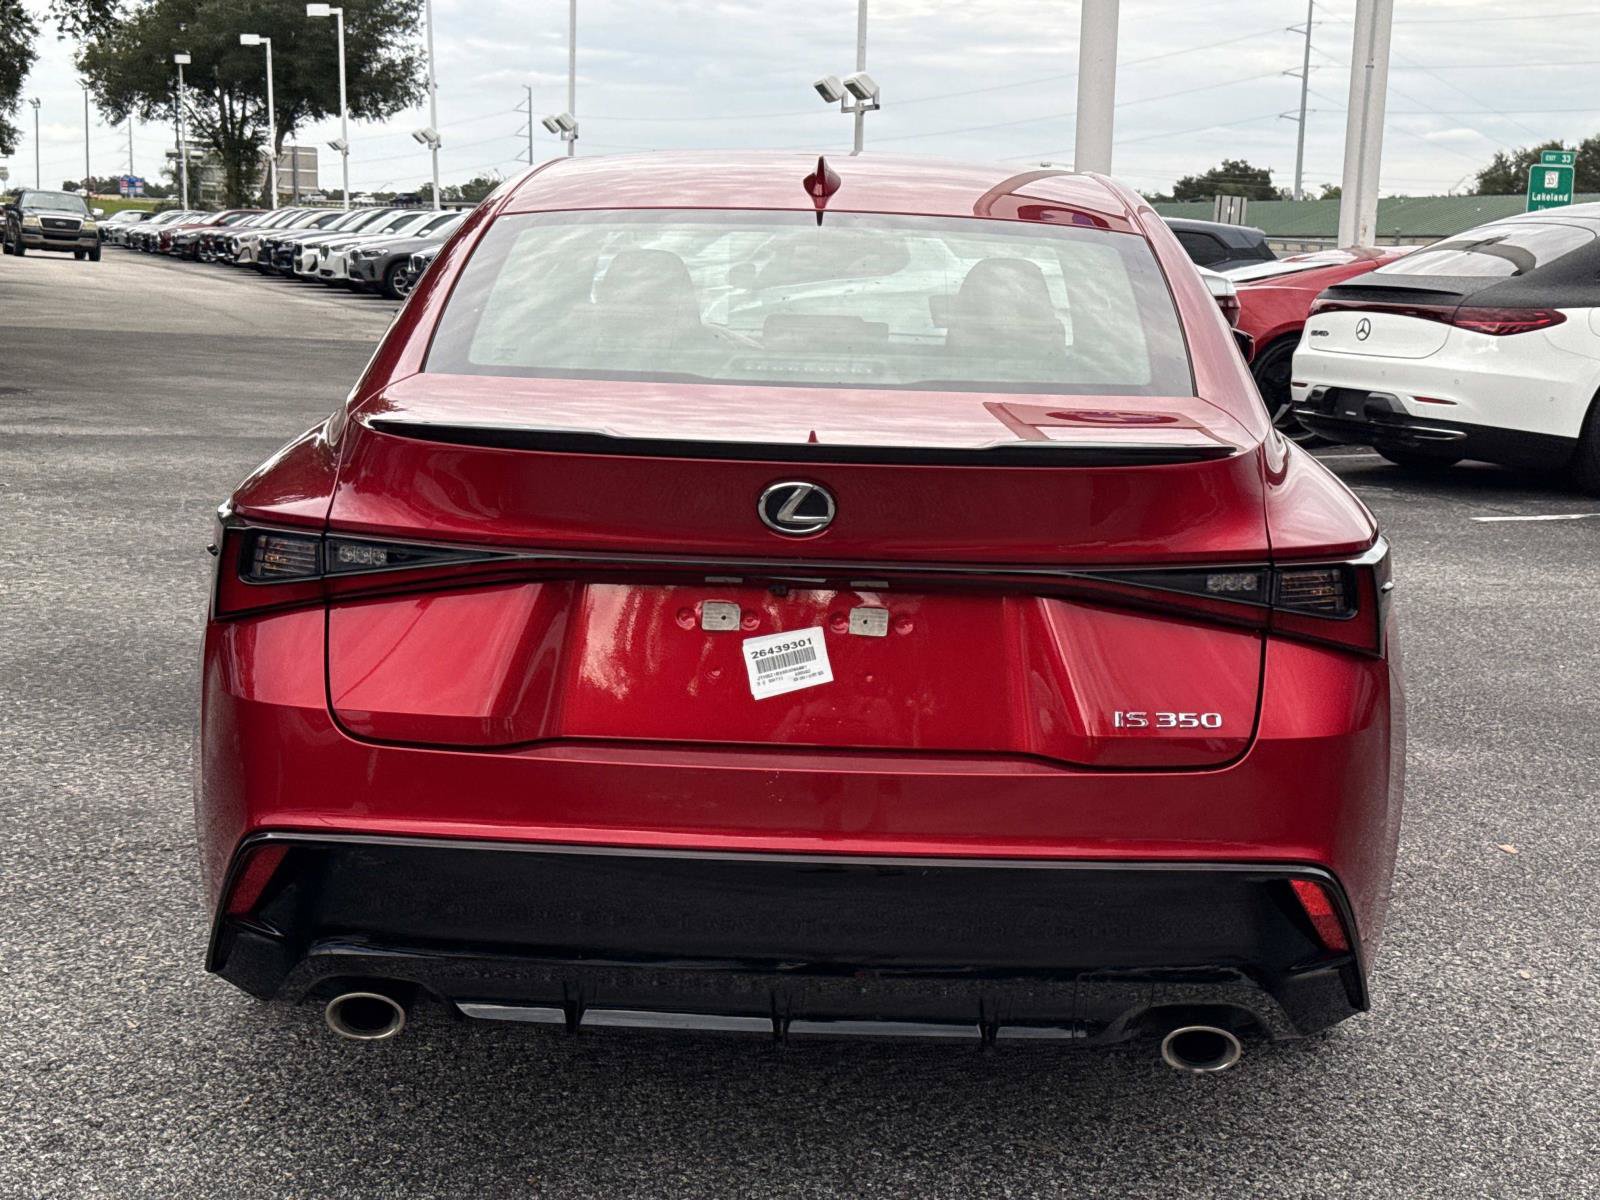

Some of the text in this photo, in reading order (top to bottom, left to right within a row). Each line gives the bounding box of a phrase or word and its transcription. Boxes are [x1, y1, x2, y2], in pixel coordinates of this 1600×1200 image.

[1561, 154, 1571, 163] 33
[1532, 192, 1568, 201] Lakeland
[751, 638, 813, 659] 26439301
[1114, 711, 1222, 728] IS 350
